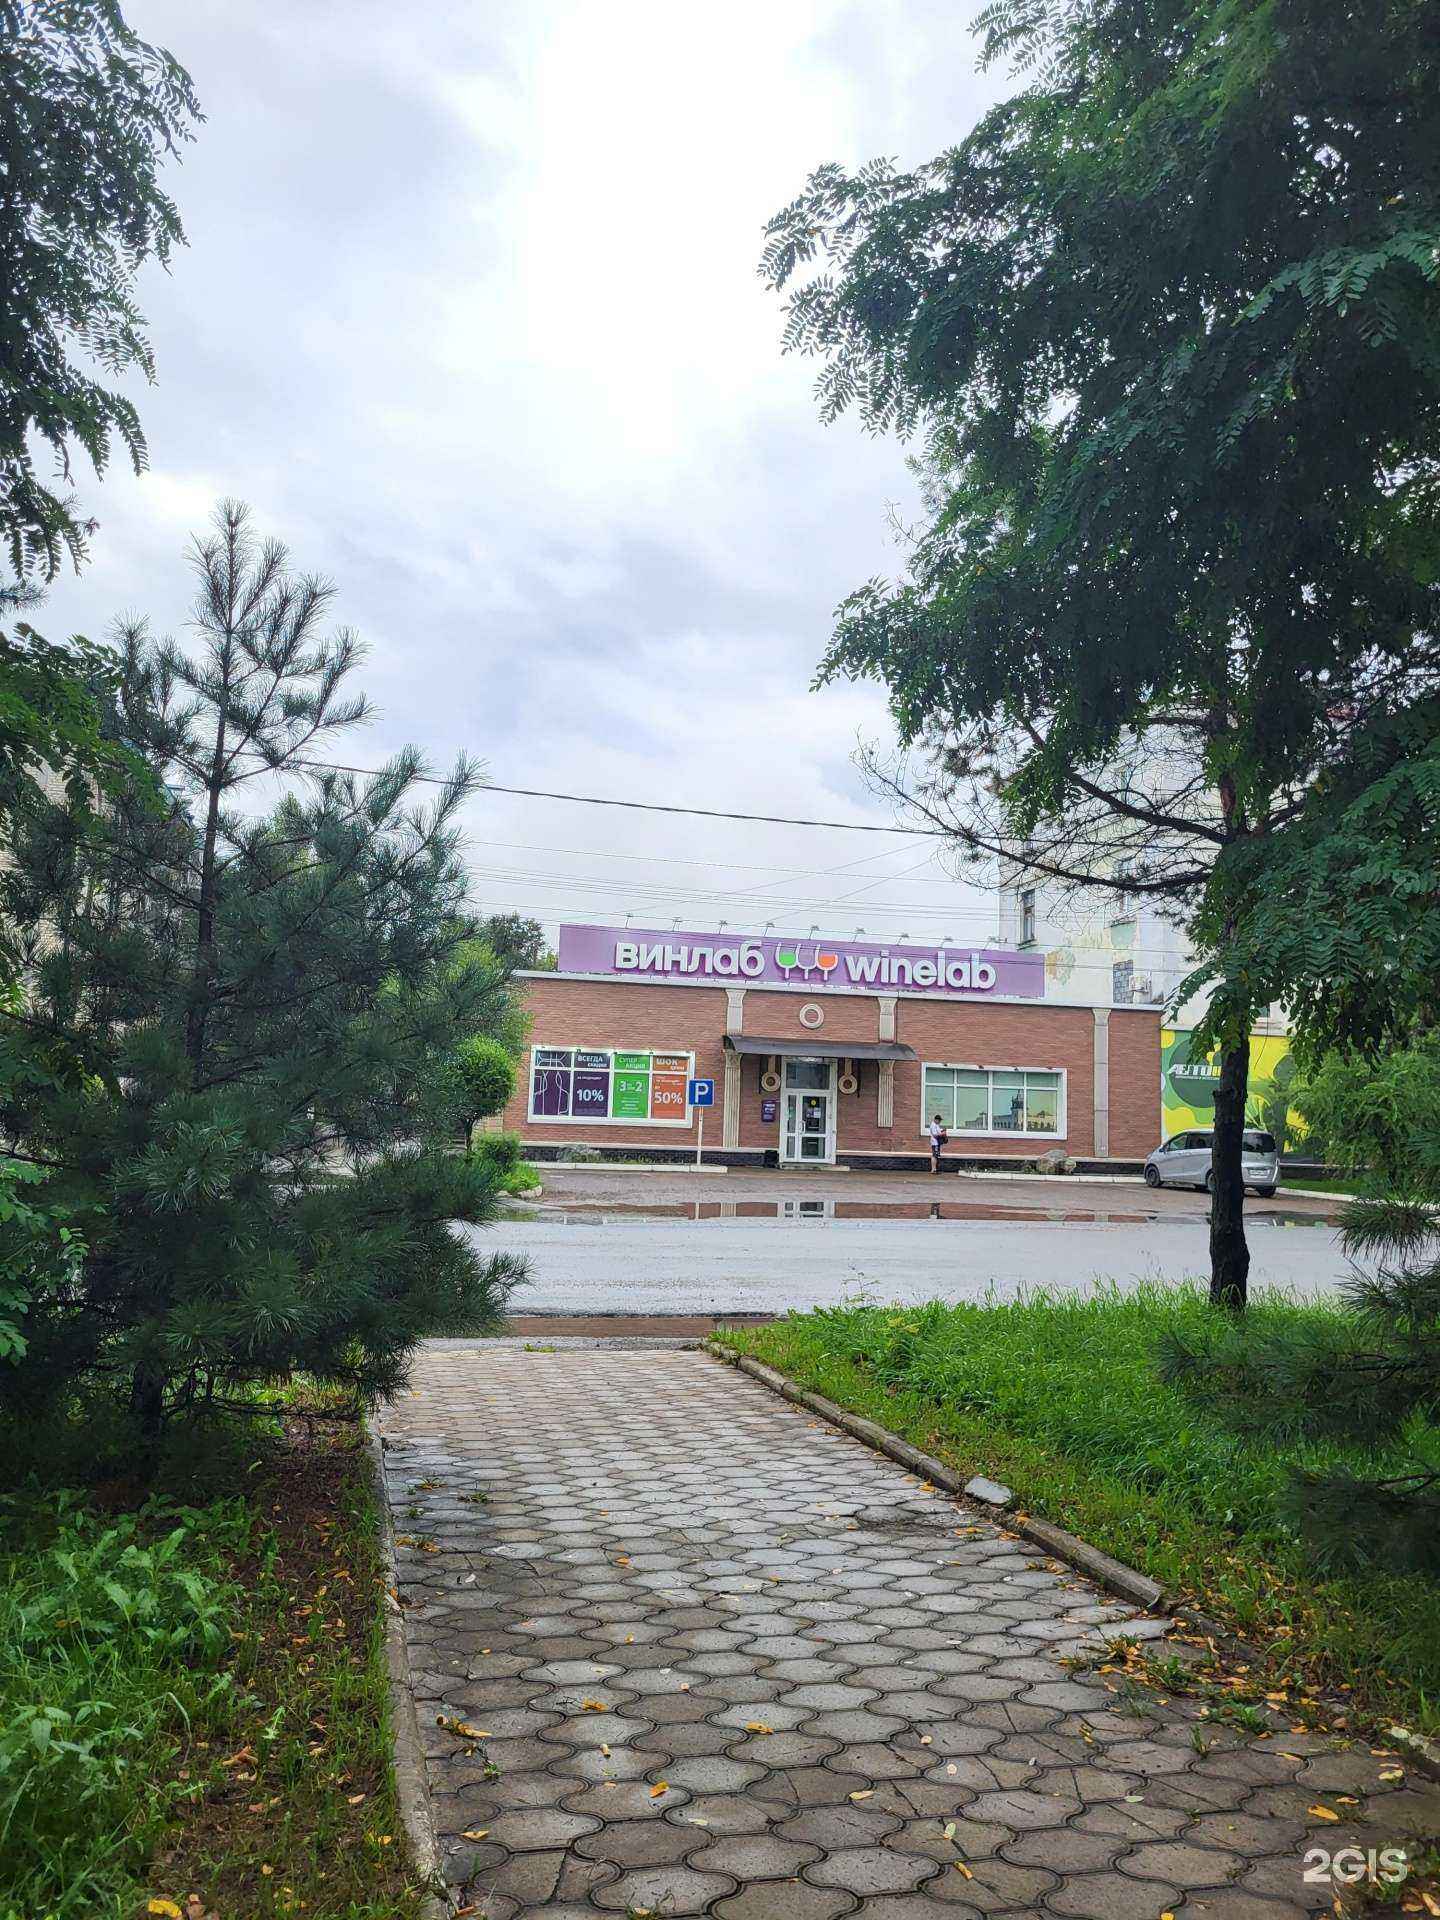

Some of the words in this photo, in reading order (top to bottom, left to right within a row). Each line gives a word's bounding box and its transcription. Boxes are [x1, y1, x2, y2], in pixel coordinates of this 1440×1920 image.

[615, 940, 765, 977] винлаб
[844, 950, 996, 989] winelab
[619, 1080, 627, 1092] 3
[635, 1081, 643, 1092] 2
[694, 1082, 709, 1103] P
[576, 1089, 604, 1102] 10%
[654, 1092, 683, 1105] 50%
